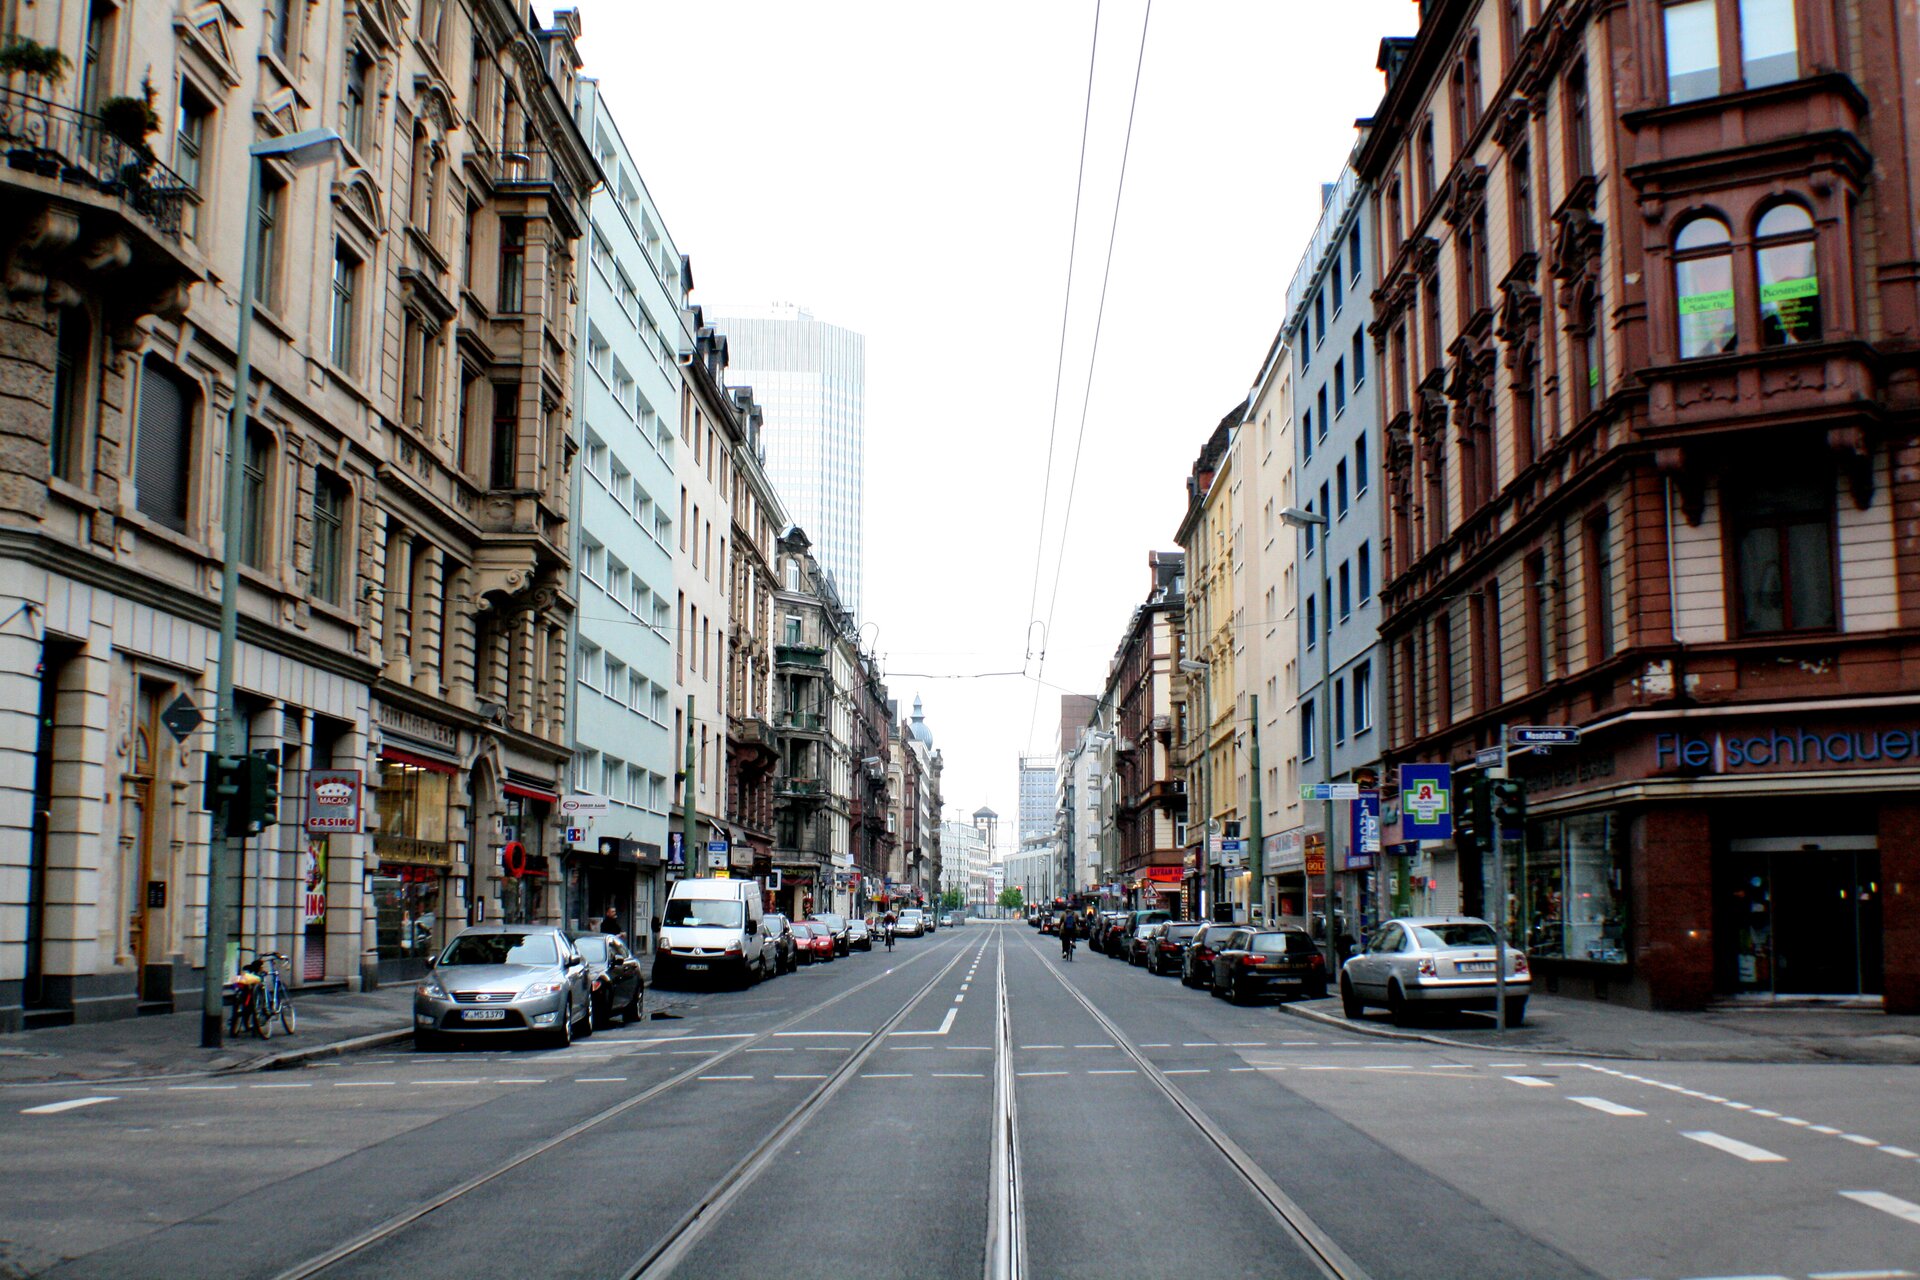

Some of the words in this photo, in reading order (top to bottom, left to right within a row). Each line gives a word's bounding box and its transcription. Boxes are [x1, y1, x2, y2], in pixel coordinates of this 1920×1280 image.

[1763, 281, 1816, 297] Kosmetik
[1526, 731, 1566, 740] Moselstraße
[310, 817, 355, 827] CASINO
[306, 894, 325, 916] INO
